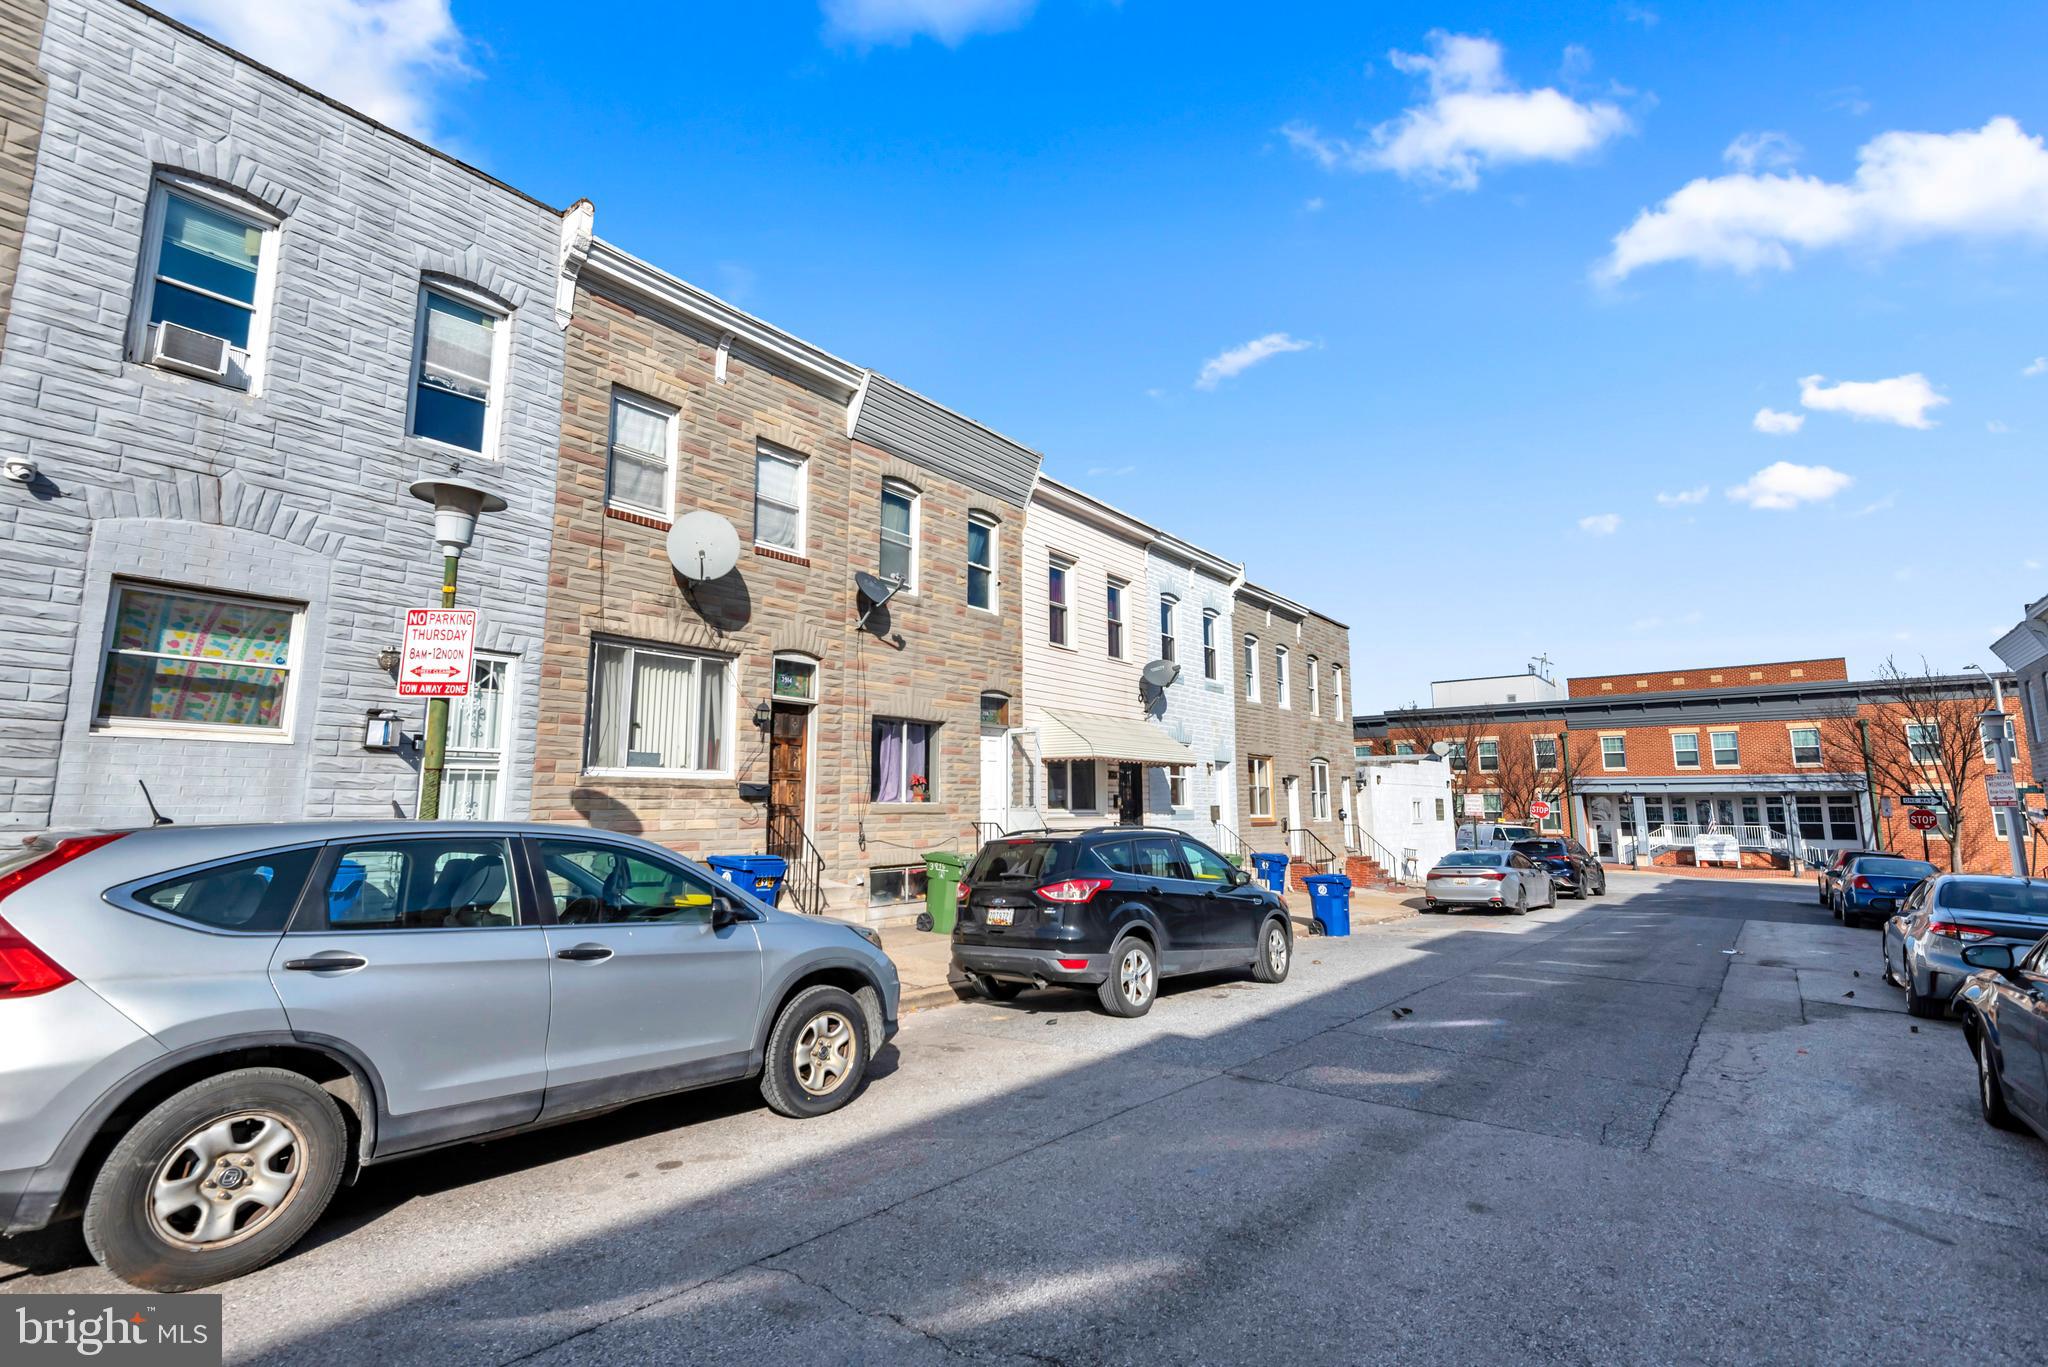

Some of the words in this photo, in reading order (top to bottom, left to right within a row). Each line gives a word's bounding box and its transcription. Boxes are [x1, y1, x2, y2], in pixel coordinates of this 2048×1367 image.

[409, 612, 427, 625] NO
[429, 613, 473, 626] PARKING
[412, 628, 467, 641] THURSDAY
[409, 647, 464, 660] 8AM-12NOON
[401, 684, 418, 693] TOW
[420, 684, 443, 693] AWAY
[445, 685, 467, 694] ZONE
[1531, 805, 1549, 814] STOP
[1910, 815, 1936, 825] STOP
